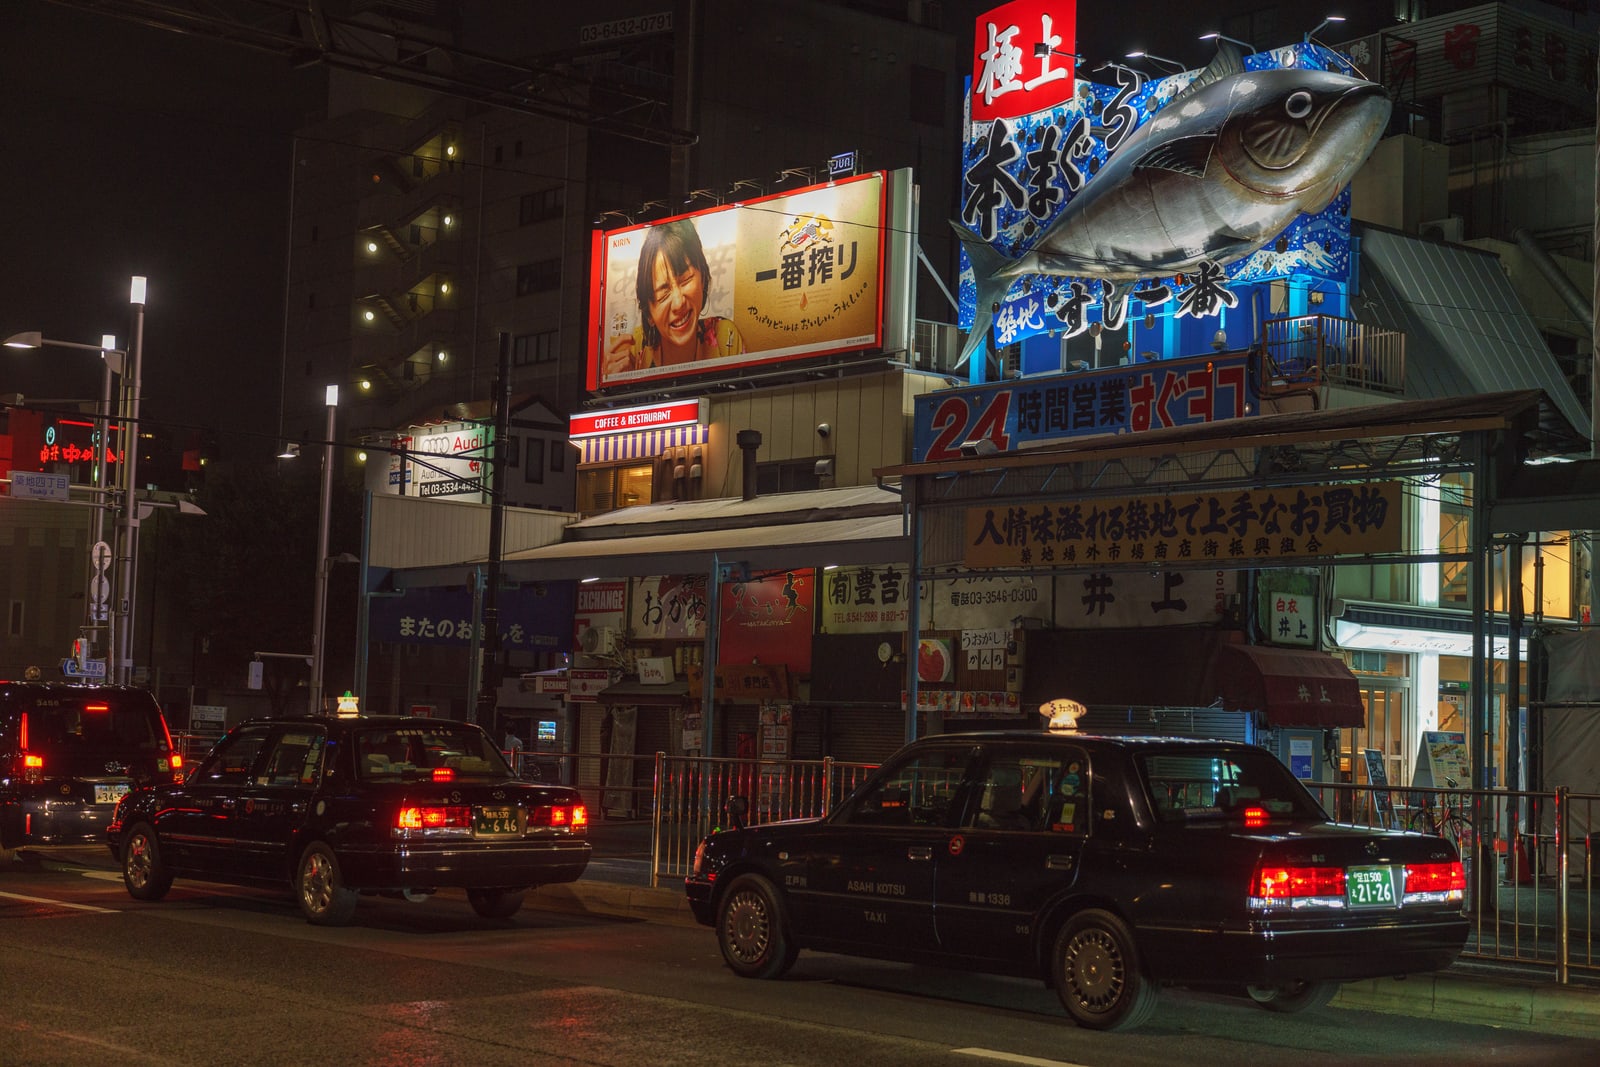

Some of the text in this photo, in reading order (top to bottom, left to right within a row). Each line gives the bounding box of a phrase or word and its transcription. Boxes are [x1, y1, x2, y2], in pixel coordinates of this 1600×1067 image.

[582, 13, 672, 41] 03-6432-0791
[976, 14, 1067, 105] 極上
[962, 65, 1142, 241] 本まぐろ
[612, 237, 631, 248] KIRIN
[755, 241, 858, 291] 一番搾り
[1055, 259, 1239, 339] すし一番
[996, 298, 1045, 343] 築地
[594, 409, 671, 429] COFFEE & RESTAURANT
[453, 434, 483, 451] Audi
[15, 475, 66, 489] 築地四丁目
[421, 484, 430, 496] Tel
[973, 485, 1389, 546] 人情味溢れる築地で上手なお買物
[1021, 535, 1322, 564] 築地場外市場商店街振興組合
[578, 590, 624, 609] EXCHANGE
[1081, 571, 1187, 616] 井上
[642, 590, 706, 625] おかめ
[1276, 598, 1298, 613] 白衣
[1278, 616, 1308, 639] 井上
[1298, 684, 1331, 703] 井上
[847, 880, 906, 896] ASAHI KOTSU
[1357, 883, 1392, 902] 21-26
[863, 910, 888, 923] TAXI
